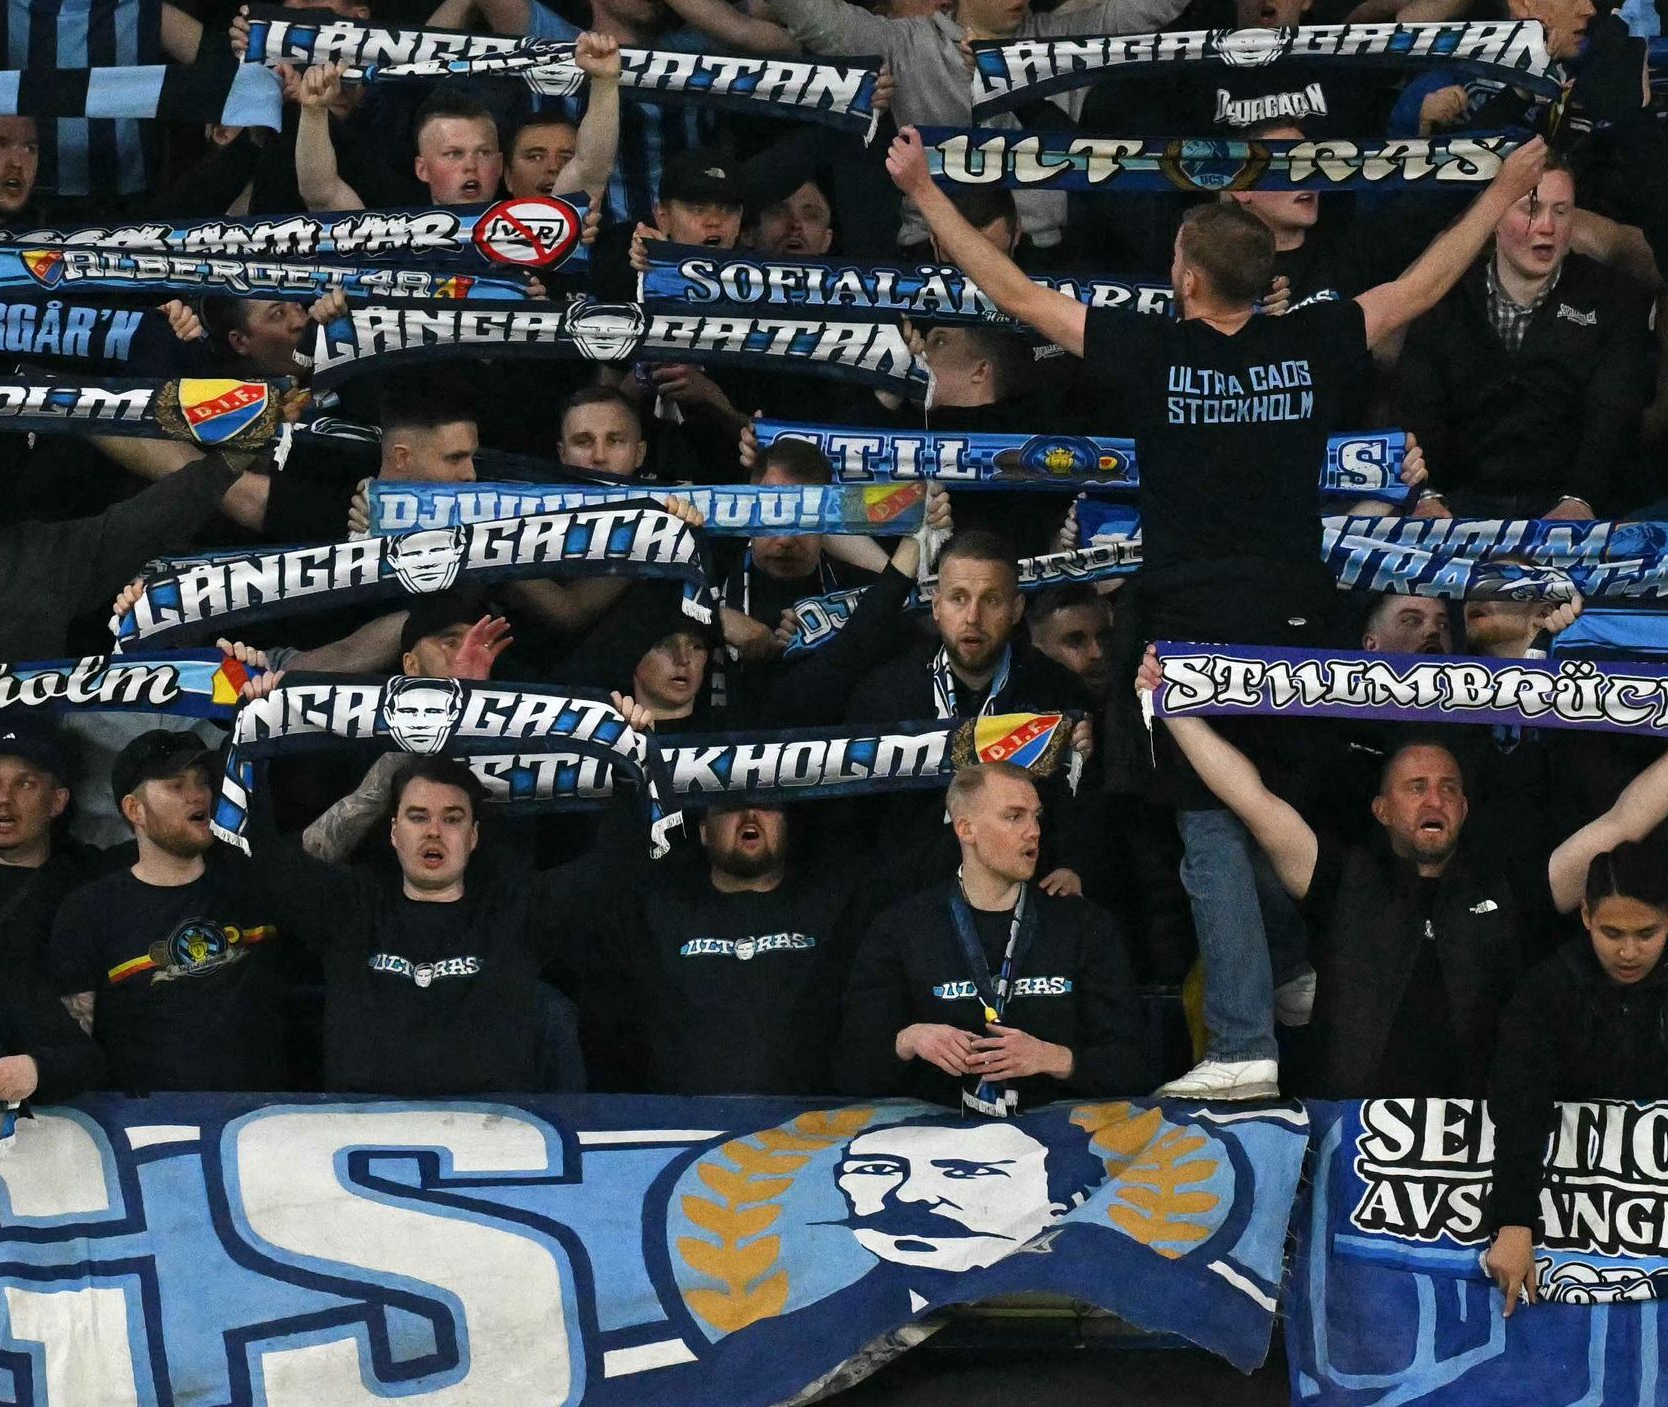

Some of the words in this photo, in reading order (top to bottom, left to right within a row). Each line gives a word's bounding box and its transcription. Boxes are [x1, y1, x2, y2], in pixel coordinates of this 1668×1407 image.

[1167, 363, 1245, 399] ULTRA
[1166, 393, 1315, 426] STOCKHOLM
[774, 435, 978, 480] TIL
[461, 508, 694, 573] GATA
